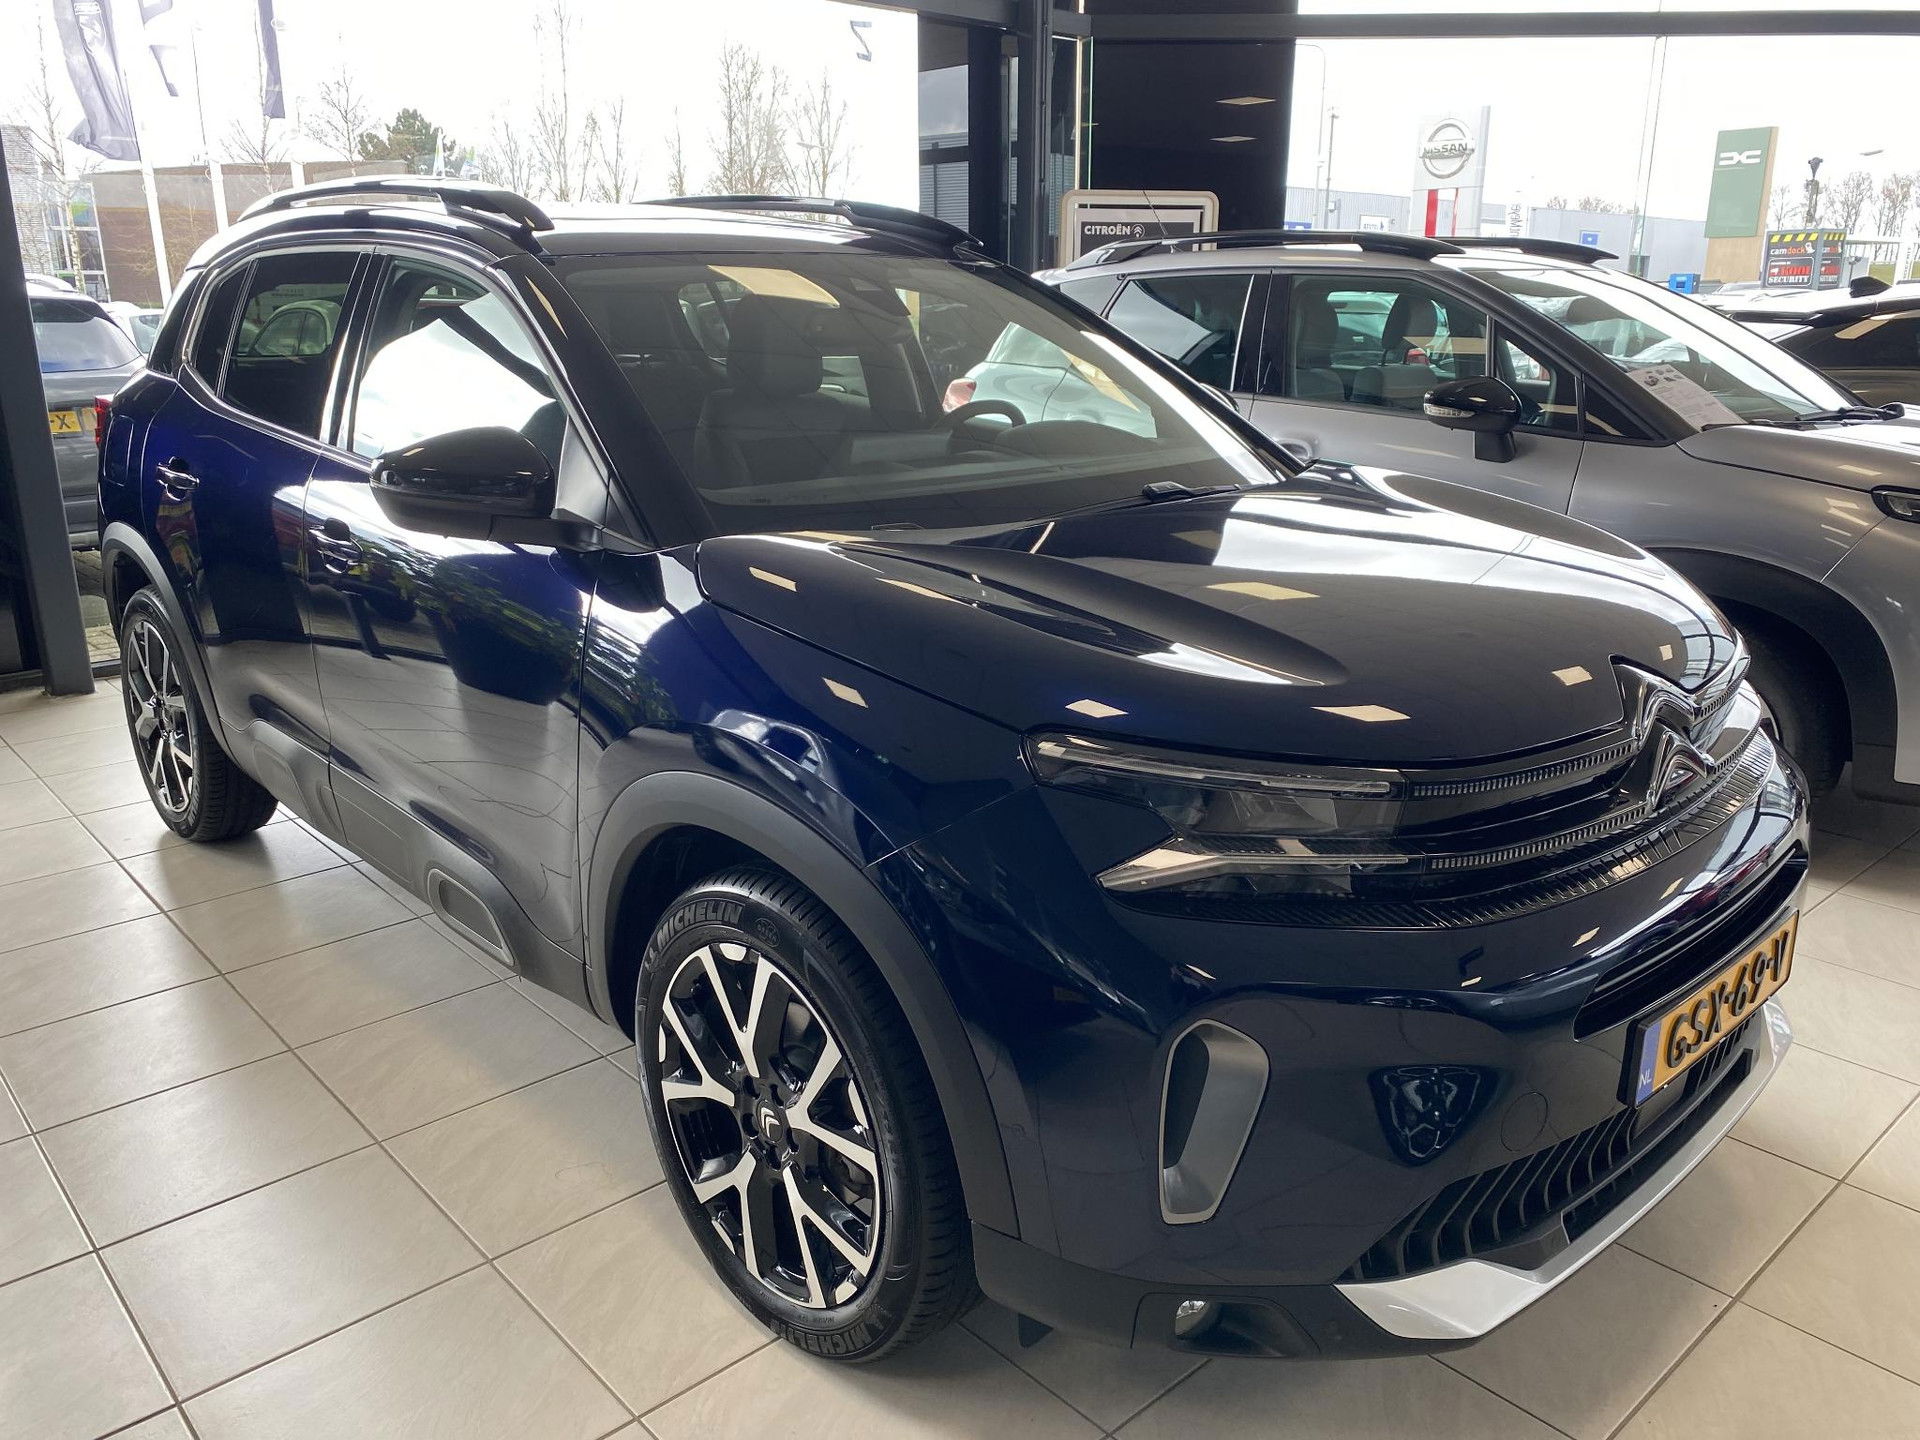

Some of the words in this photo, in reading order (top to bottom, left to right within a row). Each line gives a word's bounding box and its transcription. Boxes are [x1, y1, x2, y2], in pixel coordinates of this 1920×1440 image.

[1423, 142, 1468, 155] NISSAN
[1084, 224, 1131, 235] CITROËN
[1768, 275, 1809, 283] SECURITY
[657, 901, 743, 950] MICHELIN
[1666, 929, 1790, 1069] GSX-69-V
[1638, 1068, 1652, 1089] NL
